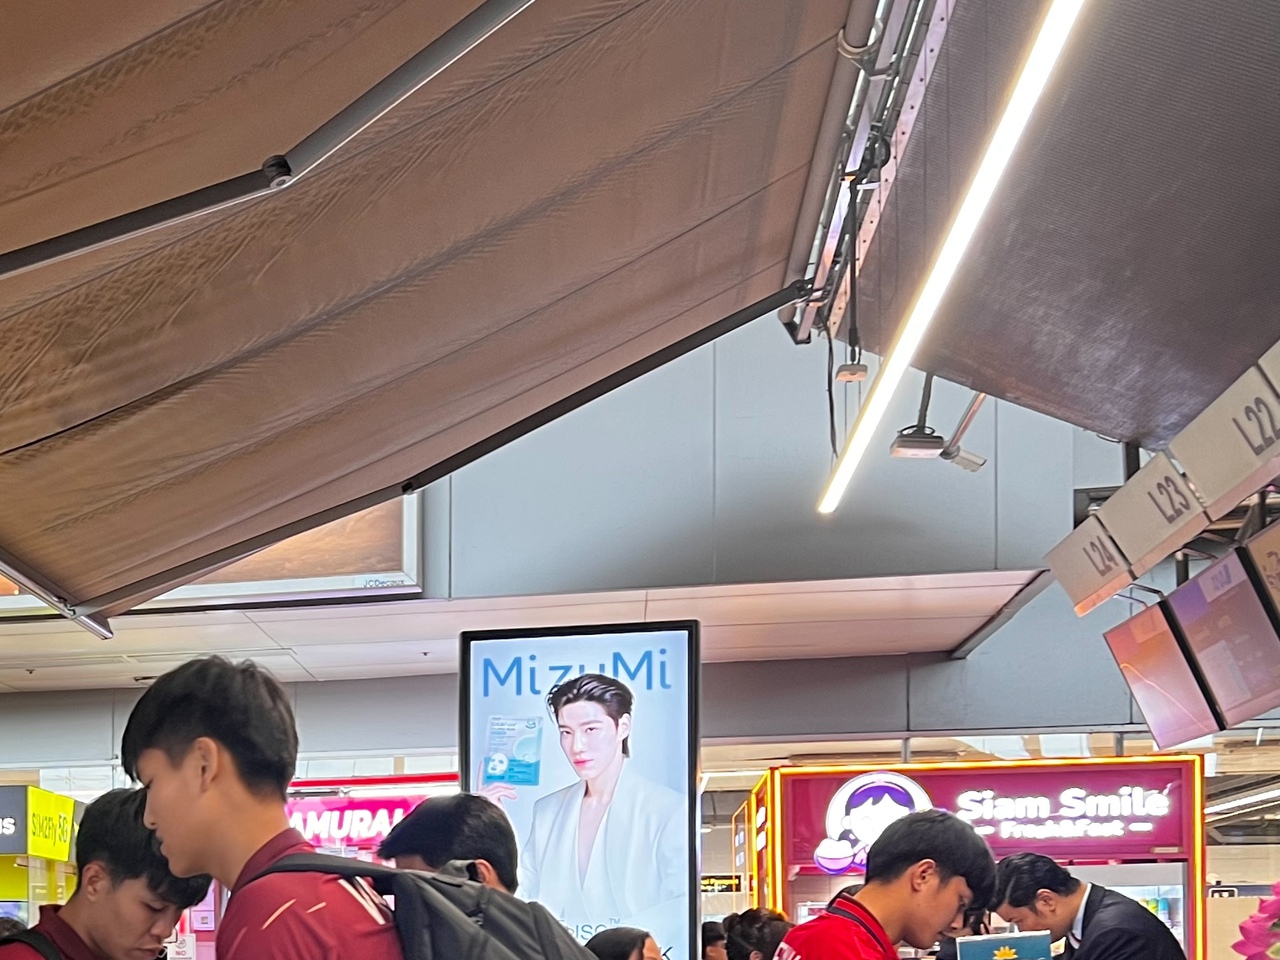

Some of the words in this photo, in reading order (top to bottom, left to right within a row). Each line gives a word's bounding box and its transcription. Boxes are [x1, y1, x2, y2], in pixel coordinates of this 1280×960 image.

[1231, 396, 1280, 457] L22
[1147, 475, 1191, 524] L23
[1082, 535, 1119, 577] L24
[955, 790, 1051, 821] Siam
[1059, 786, 1170, 817] Smile
